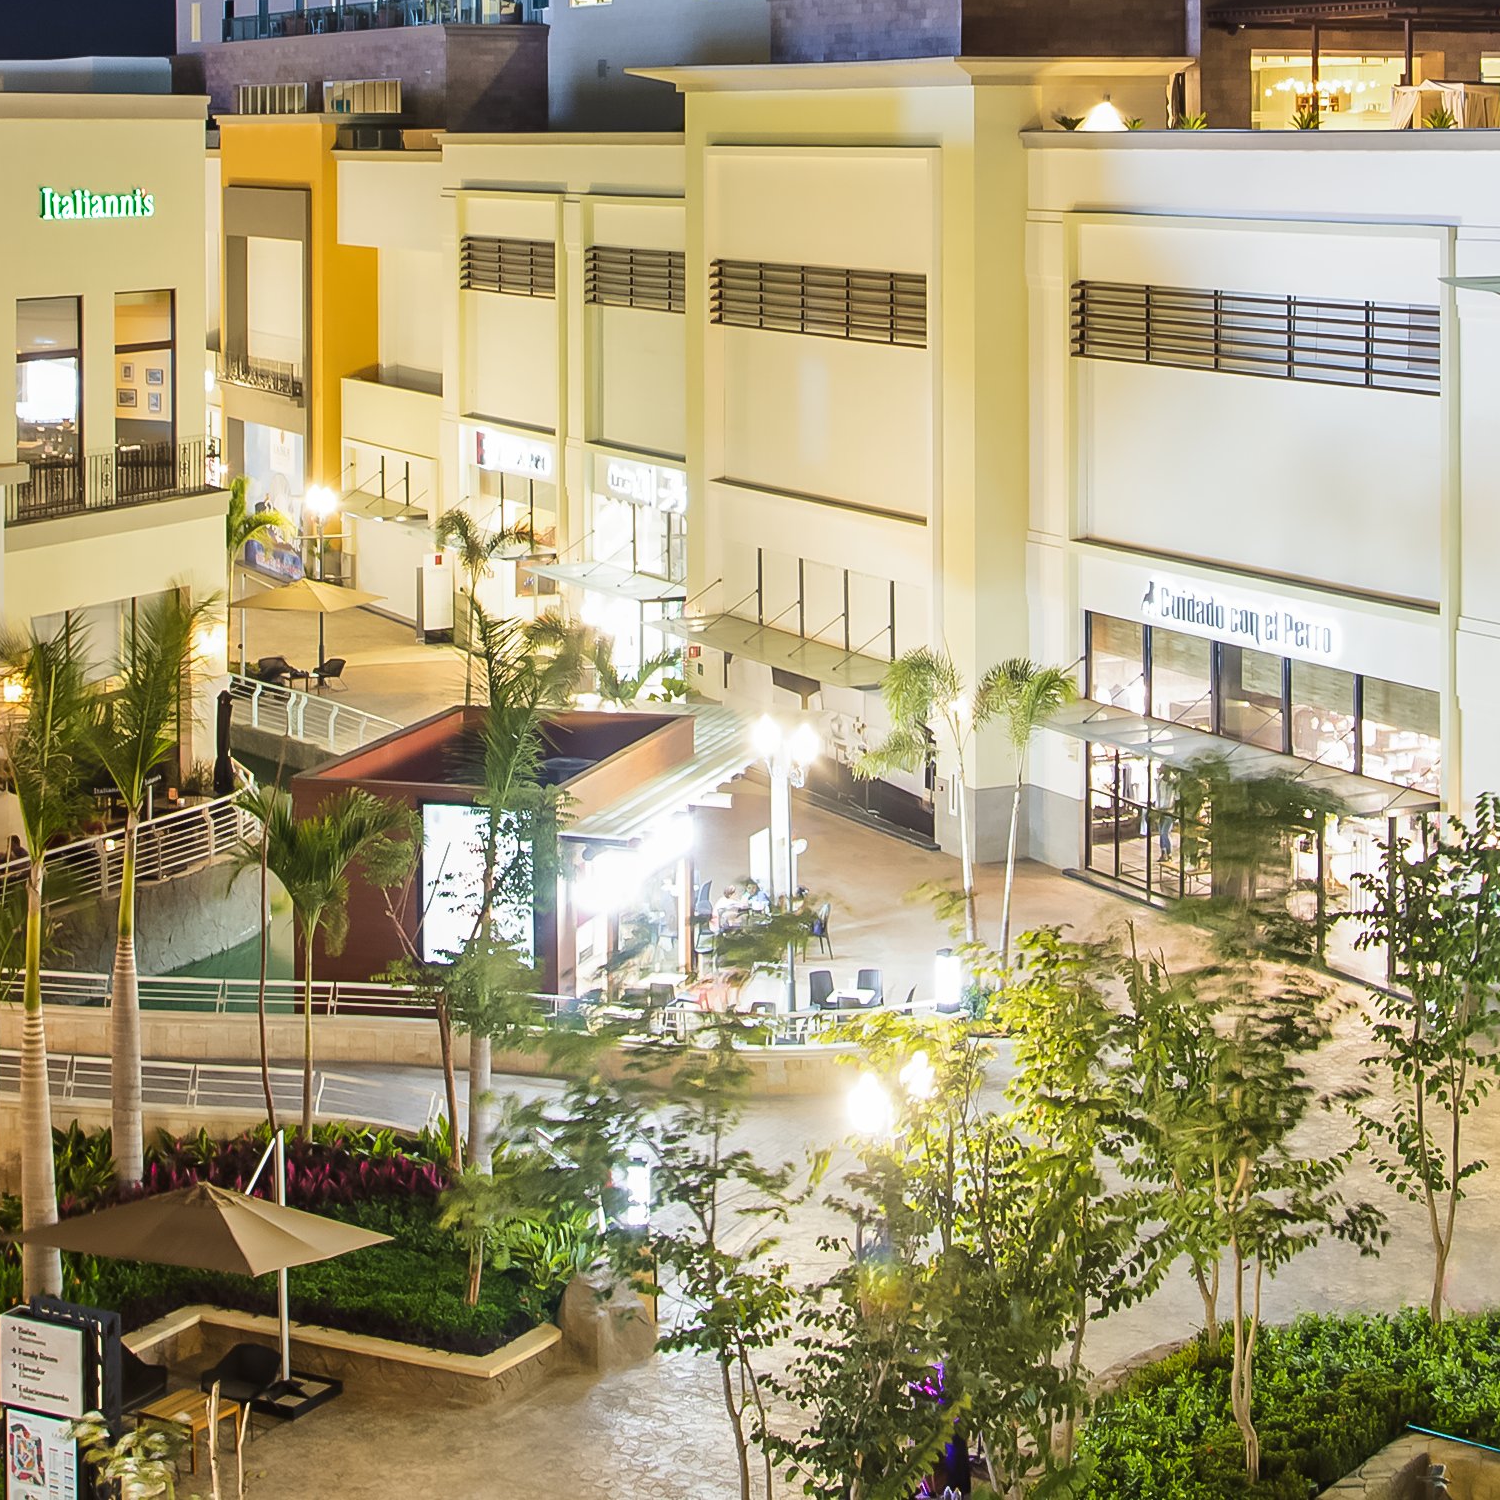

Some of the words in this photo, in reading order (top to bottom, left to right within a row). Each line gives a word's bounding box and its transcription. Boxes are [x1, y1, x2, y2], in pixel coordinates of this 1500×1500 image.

[39, 186, 155, 221] Italianni's
[1160, 586, 1225, 630] Cuidado
[1229, 607, 1261, 646] con
[1264, 610, 1279, 642] el
[1283, 613, 1332, 654] Perro
[18, 1347, 38, 1361] Family
[39, 1352, 59, 1363] Room
